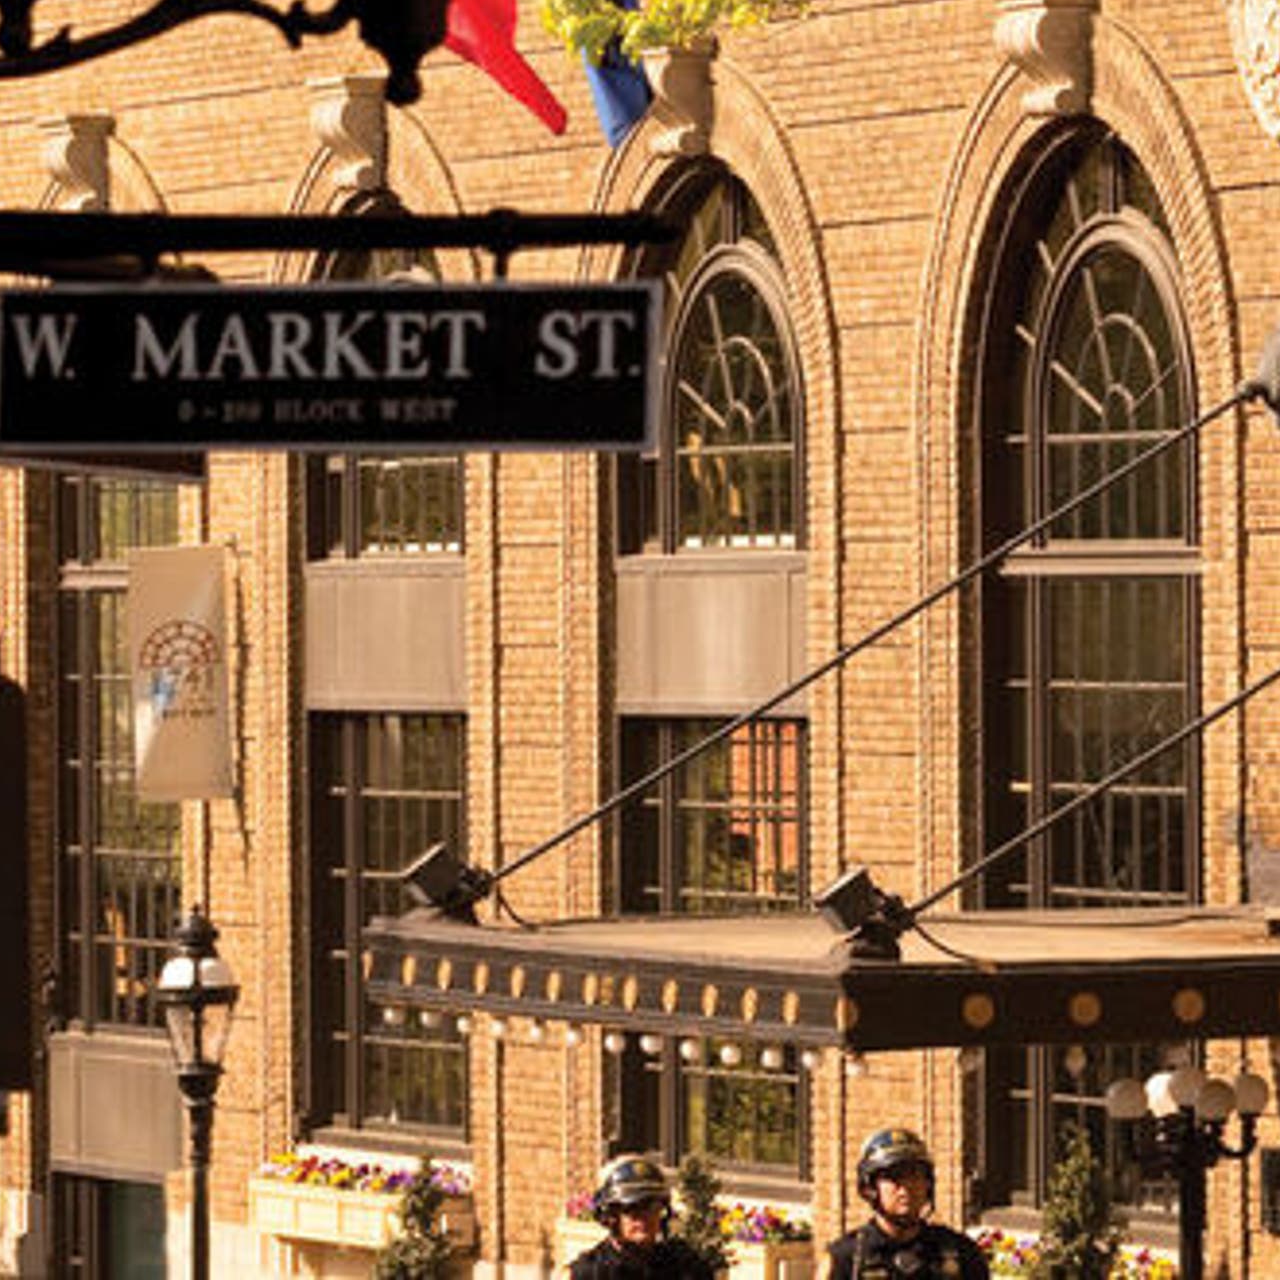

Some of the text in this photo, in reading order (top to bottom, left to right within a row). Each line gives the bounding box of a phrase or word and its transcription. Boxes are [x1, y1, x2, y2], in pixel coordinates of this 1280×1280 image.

[12, 310, 641, 380] W. MARKET ST.
[273, 397, 363, 423] BLOCK
[379, 396, 458, 423] WEST
